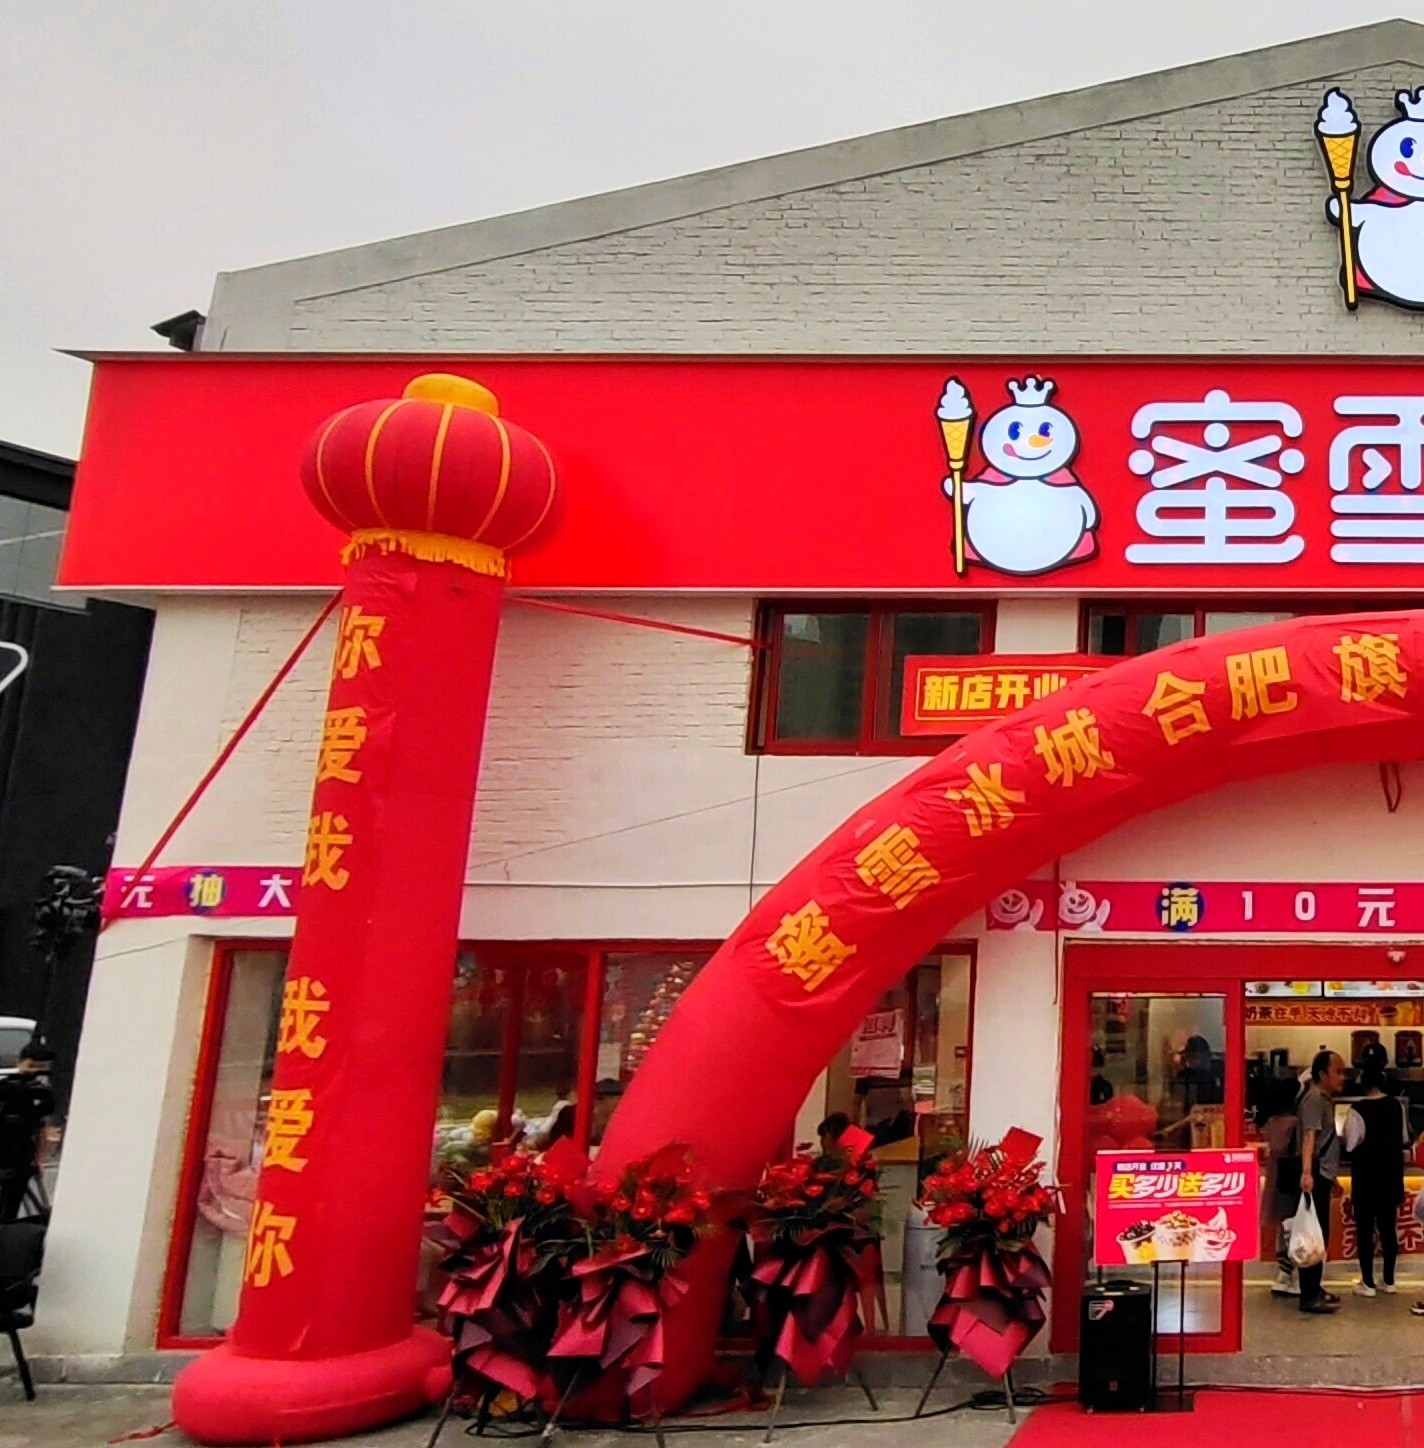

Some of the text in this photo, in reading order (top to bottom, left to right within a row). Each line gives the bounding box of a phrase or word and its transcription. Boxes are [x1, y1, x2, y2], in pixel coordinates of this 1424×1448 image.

[923, 672, 1088, 711] 新店开业
[1108, 1172, 1246, 1199] 买多少送多少
